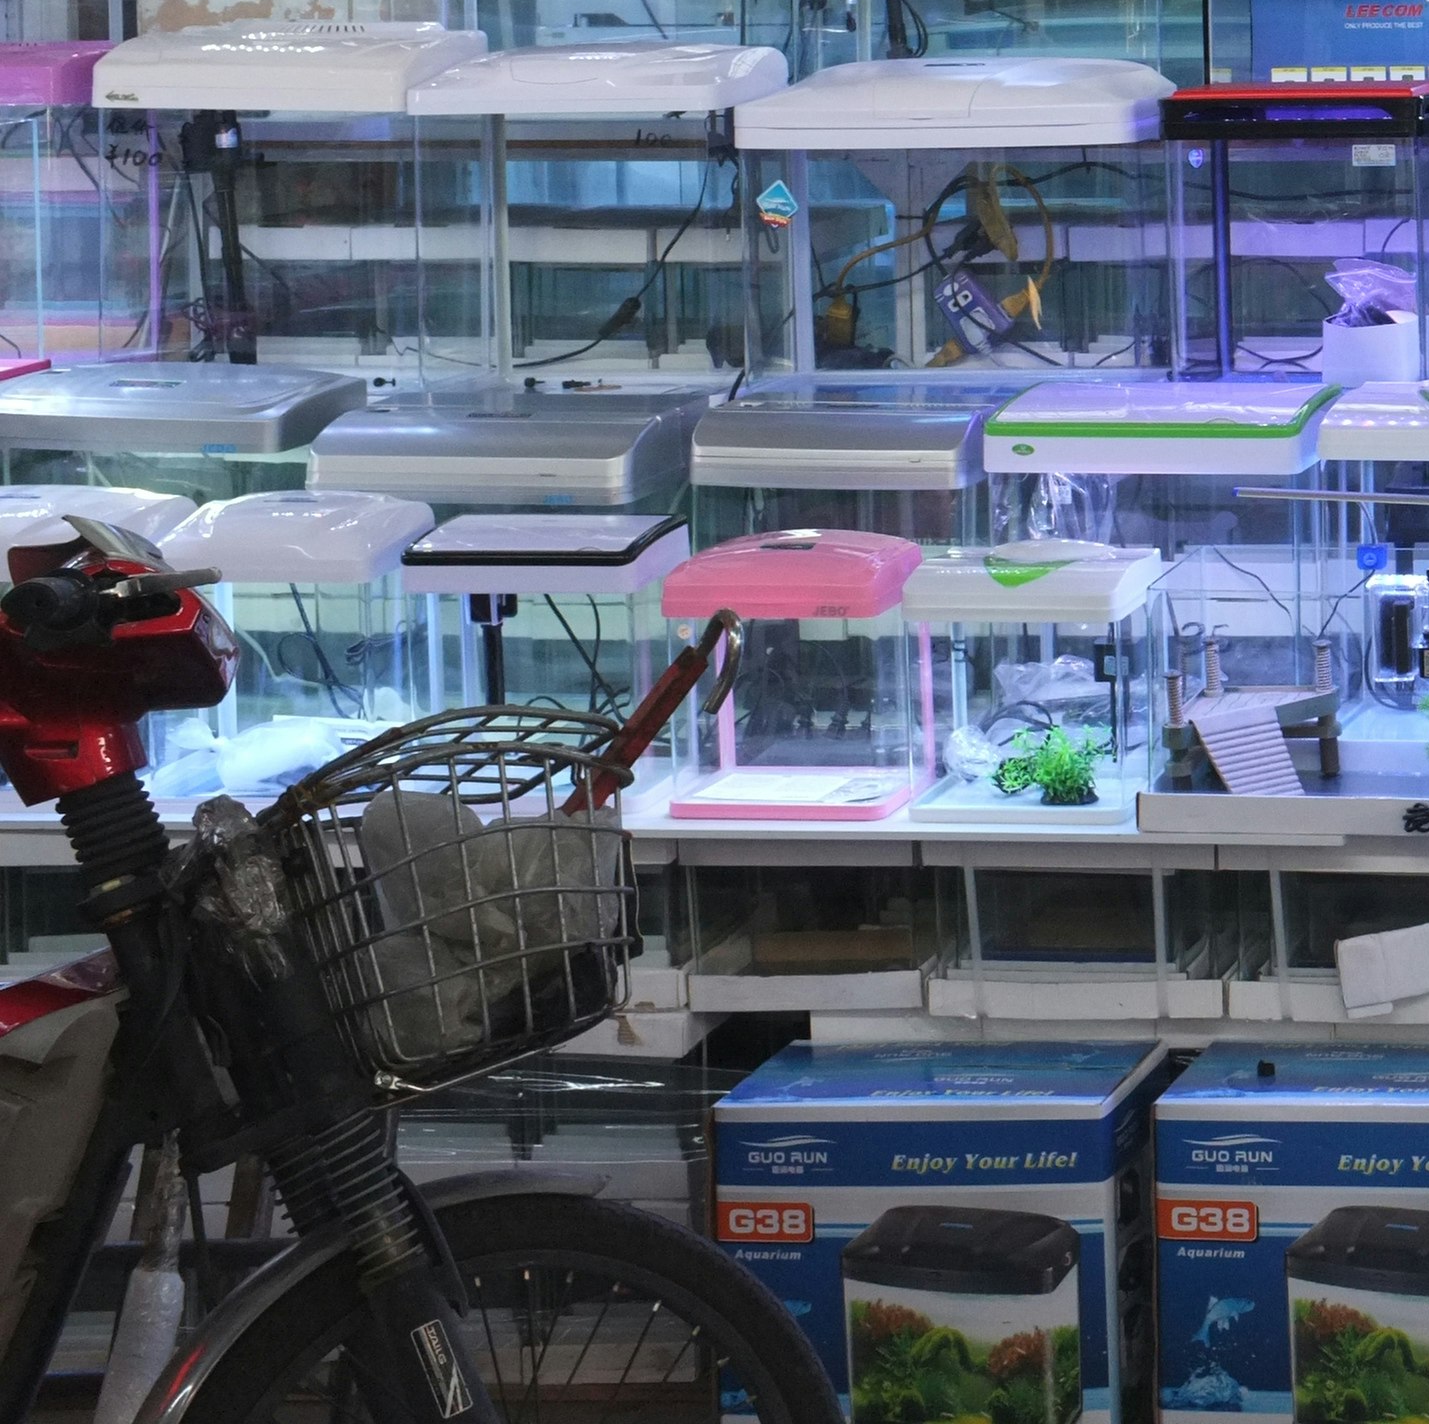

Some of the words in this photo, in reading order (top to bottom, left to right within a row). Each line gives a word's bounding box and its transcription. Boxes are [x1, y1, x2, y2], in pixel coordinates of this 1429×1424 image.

[1346, 5, 1423, 18] LEECOM
[814, 606, 848, 616] JEBO
[748, 1152, 787, 1164] GUO
[790, 1152, 828, 1164] RUN
[1191, 1151, 1230, 1162] GUO
[1233, 1150, 1273, 1162] RUN
[891, 1153, 958, 1175] Enjoy
[965, 1152, 1019, 1170] Your
[1024, 1151, 1079, 1169] Life!
[1337, 1154, 1403, 1175] Enjoy
[729, 1208, 807, 1235] G38
[1171, 1206, 1250, 1233] G38
[735, 1249, 802, 1261] Aquarium
[1177, 1246, 1245, 1258] Aquarium
